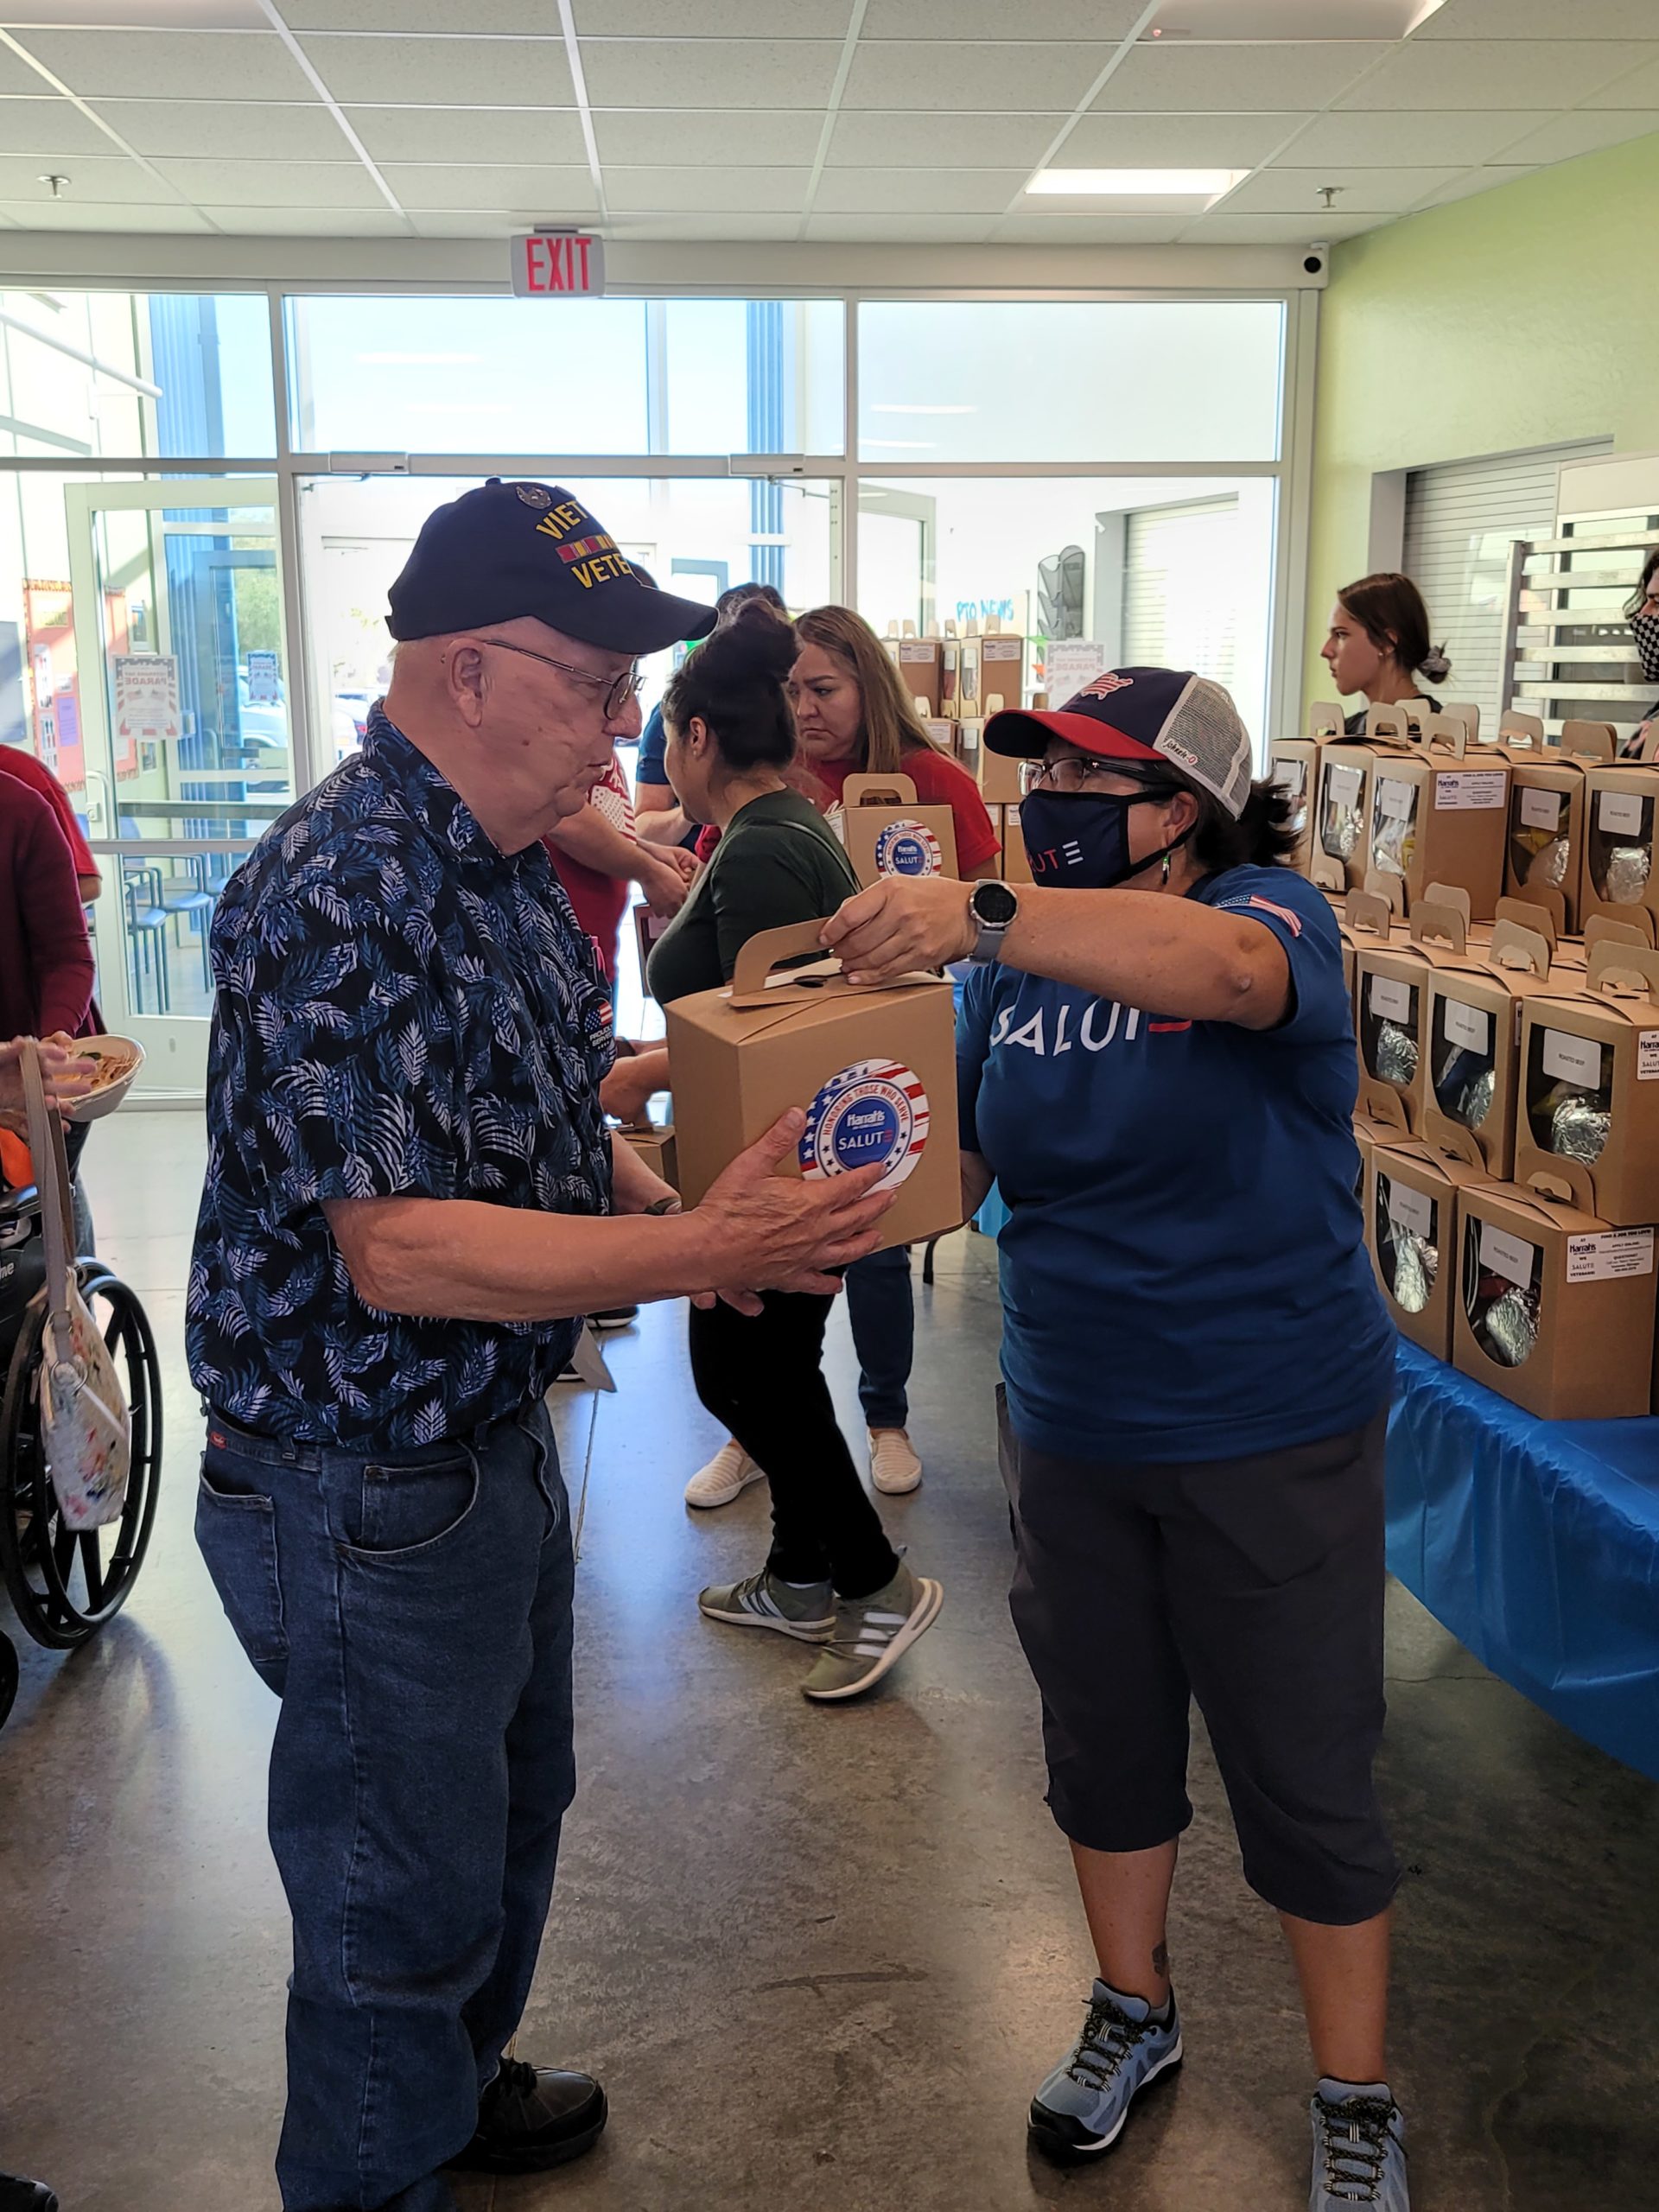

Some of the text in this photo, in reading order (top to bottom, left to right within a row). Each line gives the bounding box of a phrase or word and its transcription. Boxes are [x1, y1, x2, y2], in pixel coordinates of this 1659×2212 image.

[526, 238, 592, 291] EXIT
[980, 598, 1014, 620] NEWS
[880, 1085, 898, 1102] WHO
[894, 1096, 909, 1123] SERVE
[837, 1128, 893, 1151] SALUTE
